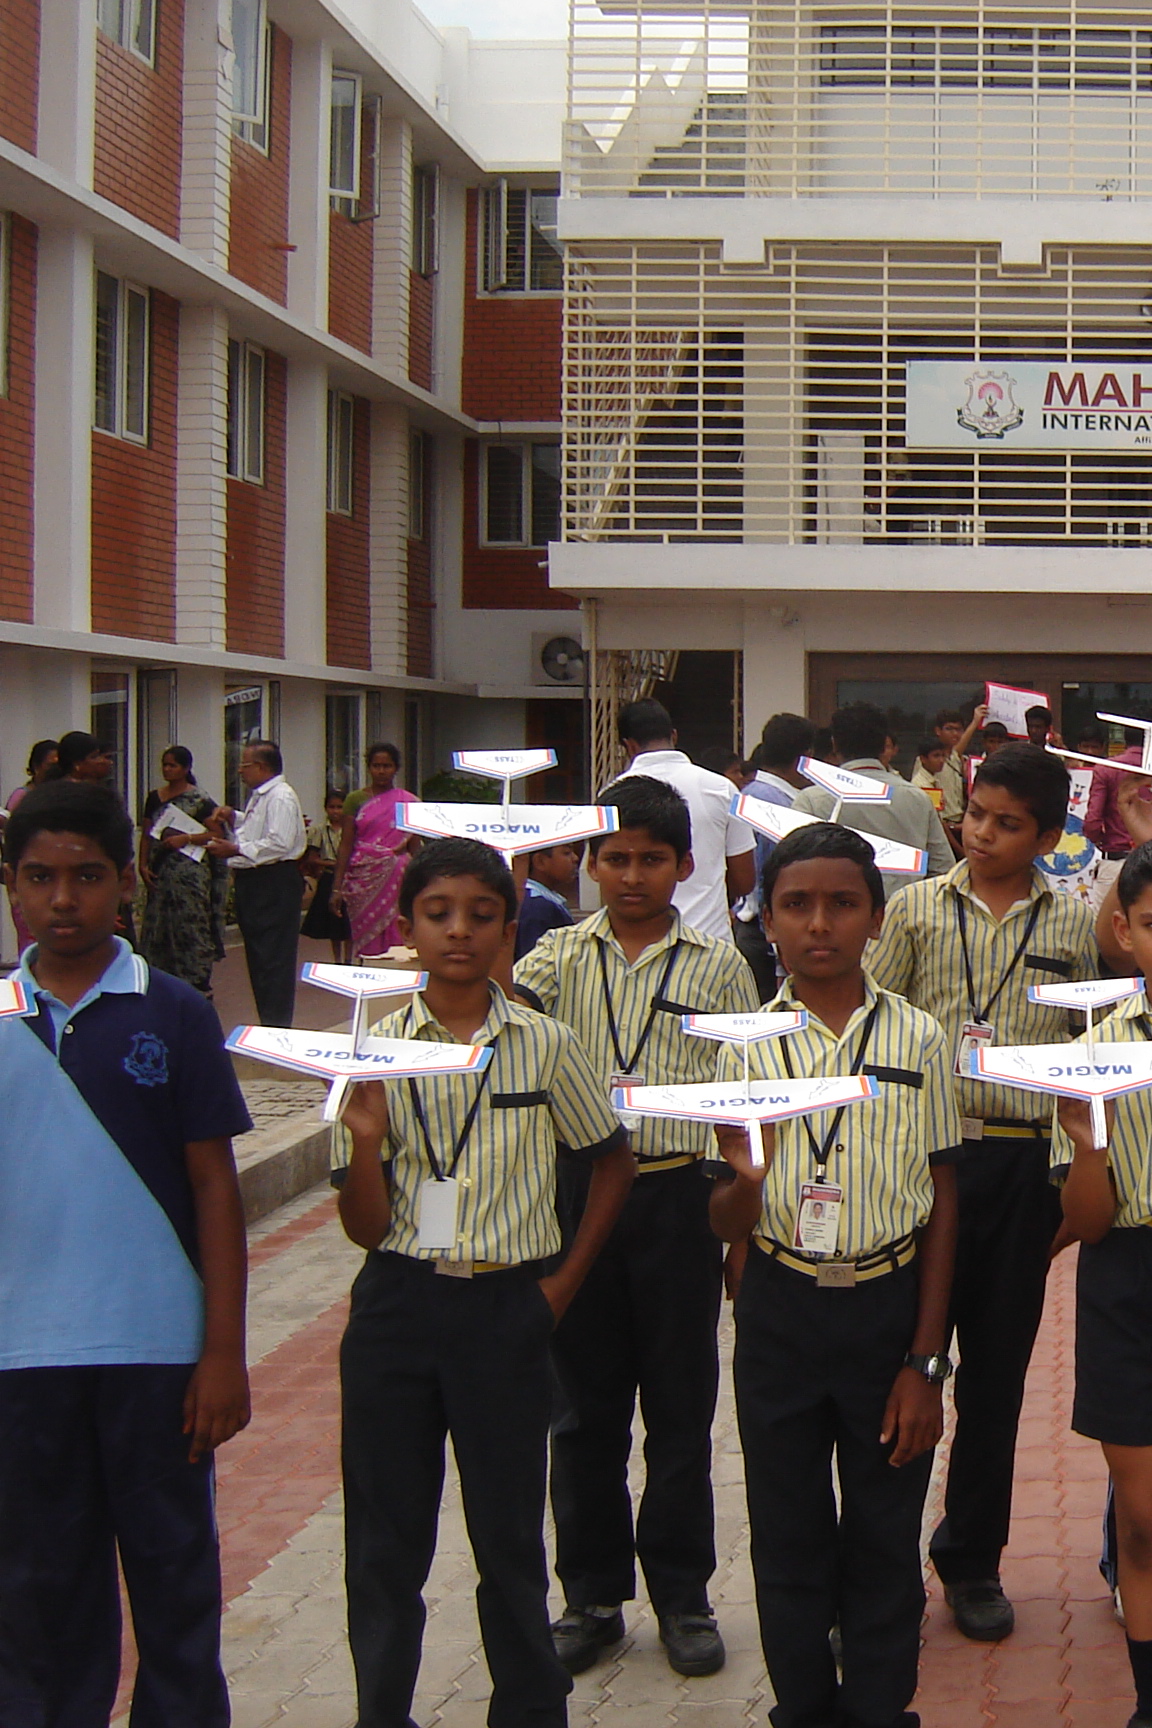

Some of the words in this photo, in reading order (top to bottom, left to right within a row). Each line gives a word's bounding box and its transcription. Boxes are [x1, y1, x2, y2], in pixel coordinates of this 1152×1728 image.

[465, 823, 541, 834] MAGIC
[352, 972, 376, 981] TASS
[304, 1048, 396, 1064] MAGIC
[1048, 1064, 1133, 1078] MAGIC
[699, 1095, 791, 1109] MAGIC
